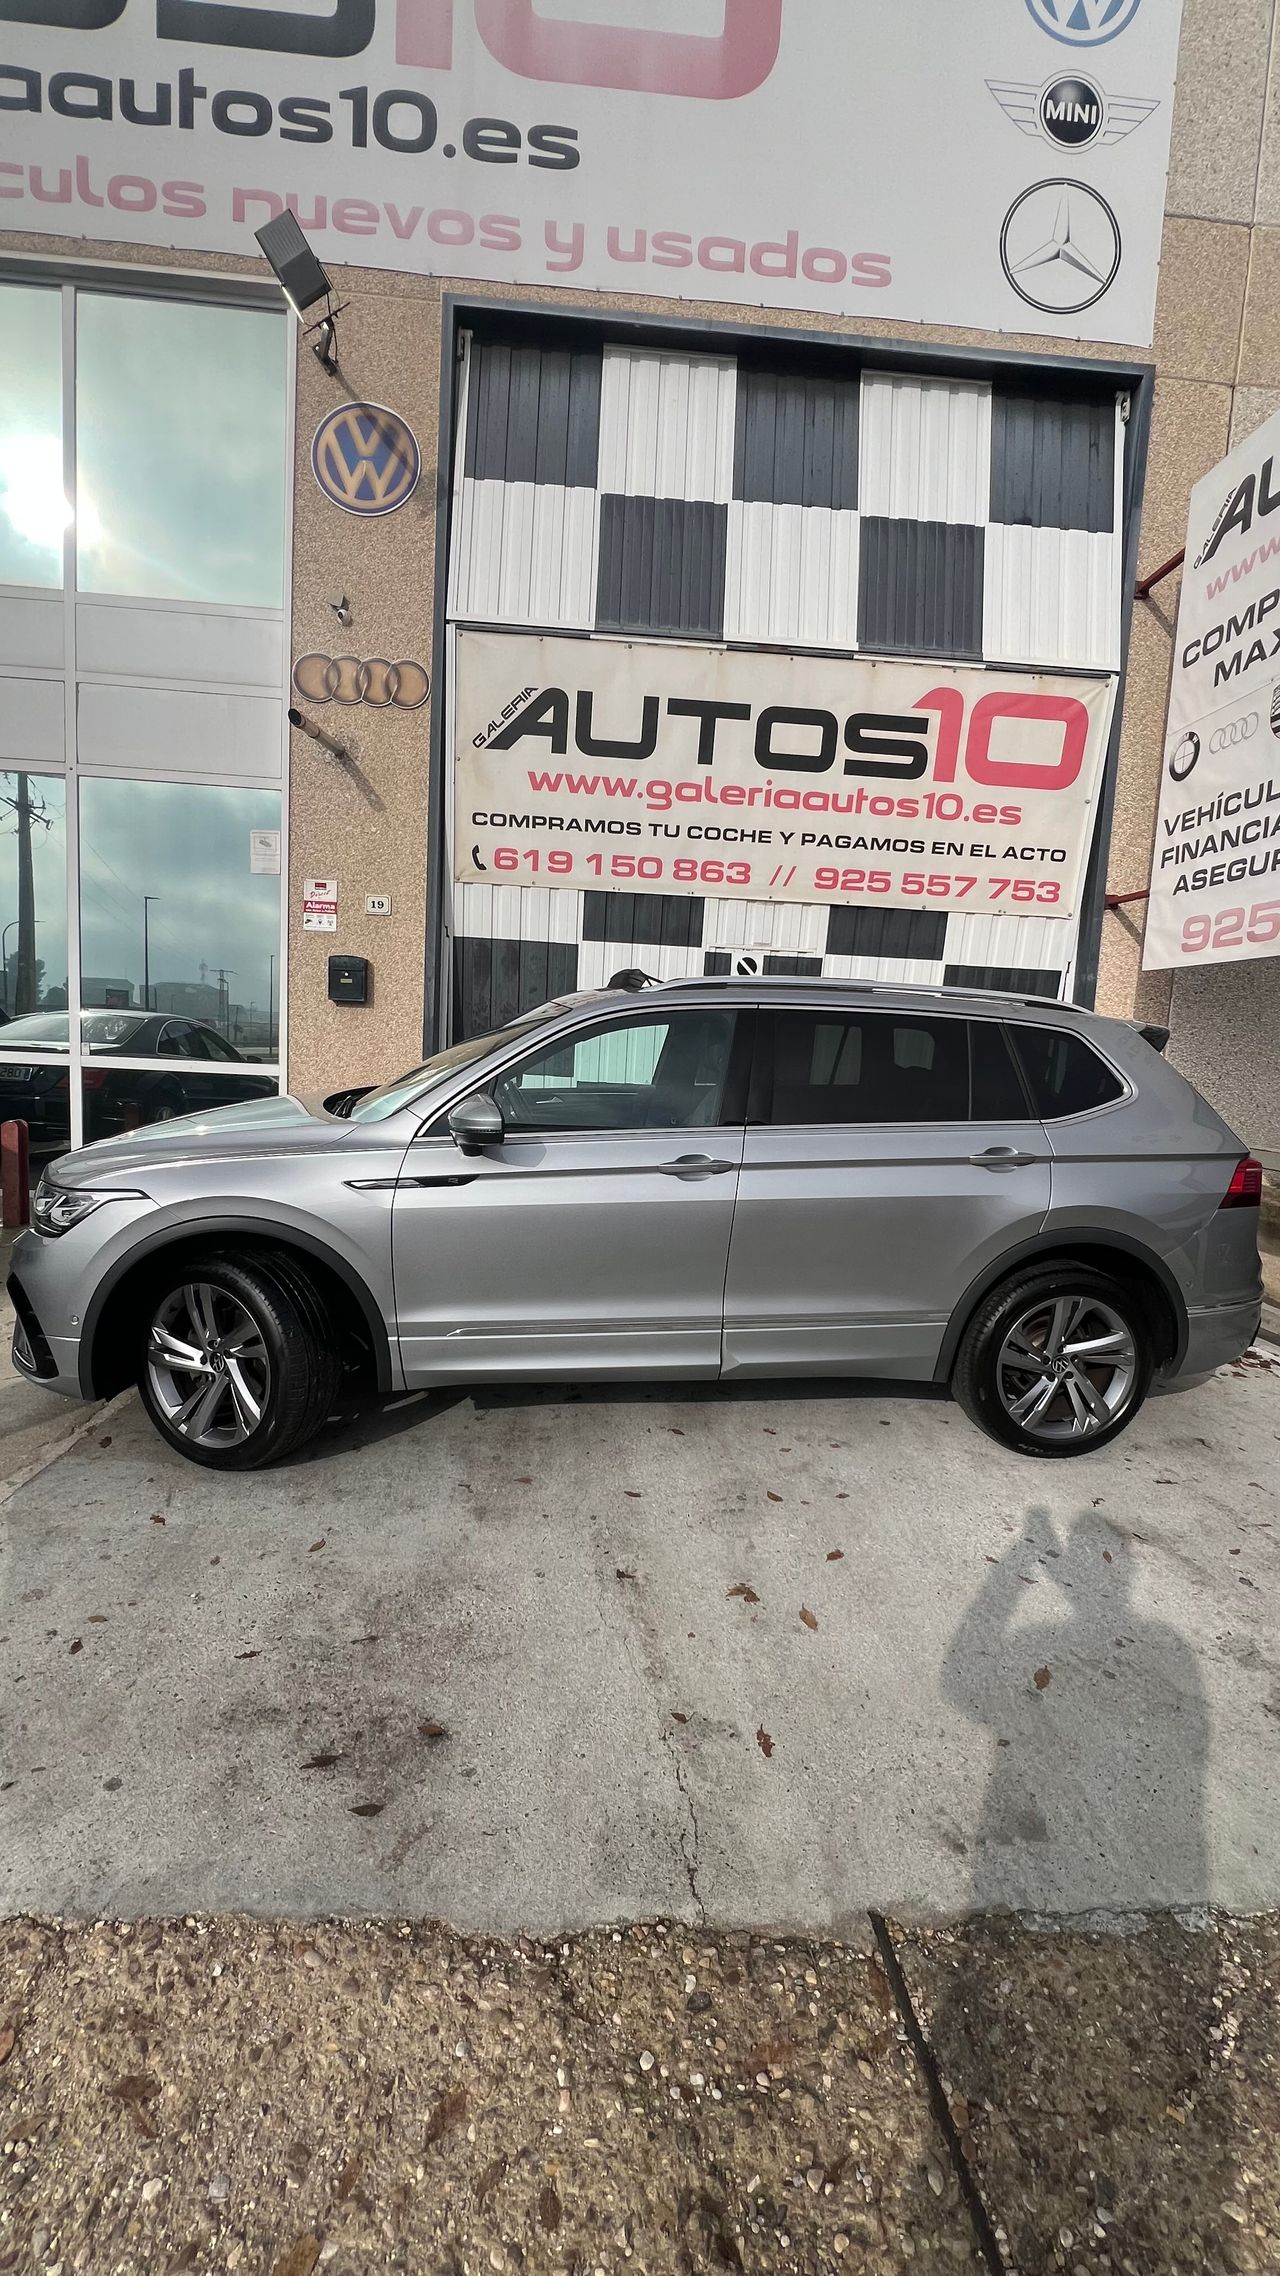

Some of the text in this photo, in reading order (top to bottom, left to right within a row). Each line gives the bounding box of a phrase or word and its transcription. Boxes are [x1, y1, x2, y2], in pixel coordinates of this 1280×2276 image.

[1046, 99, 1098, 125] MINI
[232, 186, 522, 252] nuevos
[544, 219, 585, 272] y
[606, 226, 892, 288] usados
[1193, 487, 1238, 570] GALERIA
[1182, 588, 1280, 669] COMP
[472, 687, 539, 749] GALERIA
[485, 687, 1089, 790] AUTOS10
[527, 771, 1022, 826] www.galeriaautos10.es
[471, 811, 1067, 863] COMPRAMOS TU COCHE Y PAGAMOS EN EL ACTO
[493, 847, 573, 874] 619
[586, 853, 663, 880] 150
[672, 858, 752, 885] 863
[814, 867, 892, 894] 925
[901, 872, 978, 898] 557
[988, 877, 1062, 904] 753
[306, 901, 336, 910] Alarma
[370, 901, 384, 909] 19
[1181, 900, 1280, 953] 925
